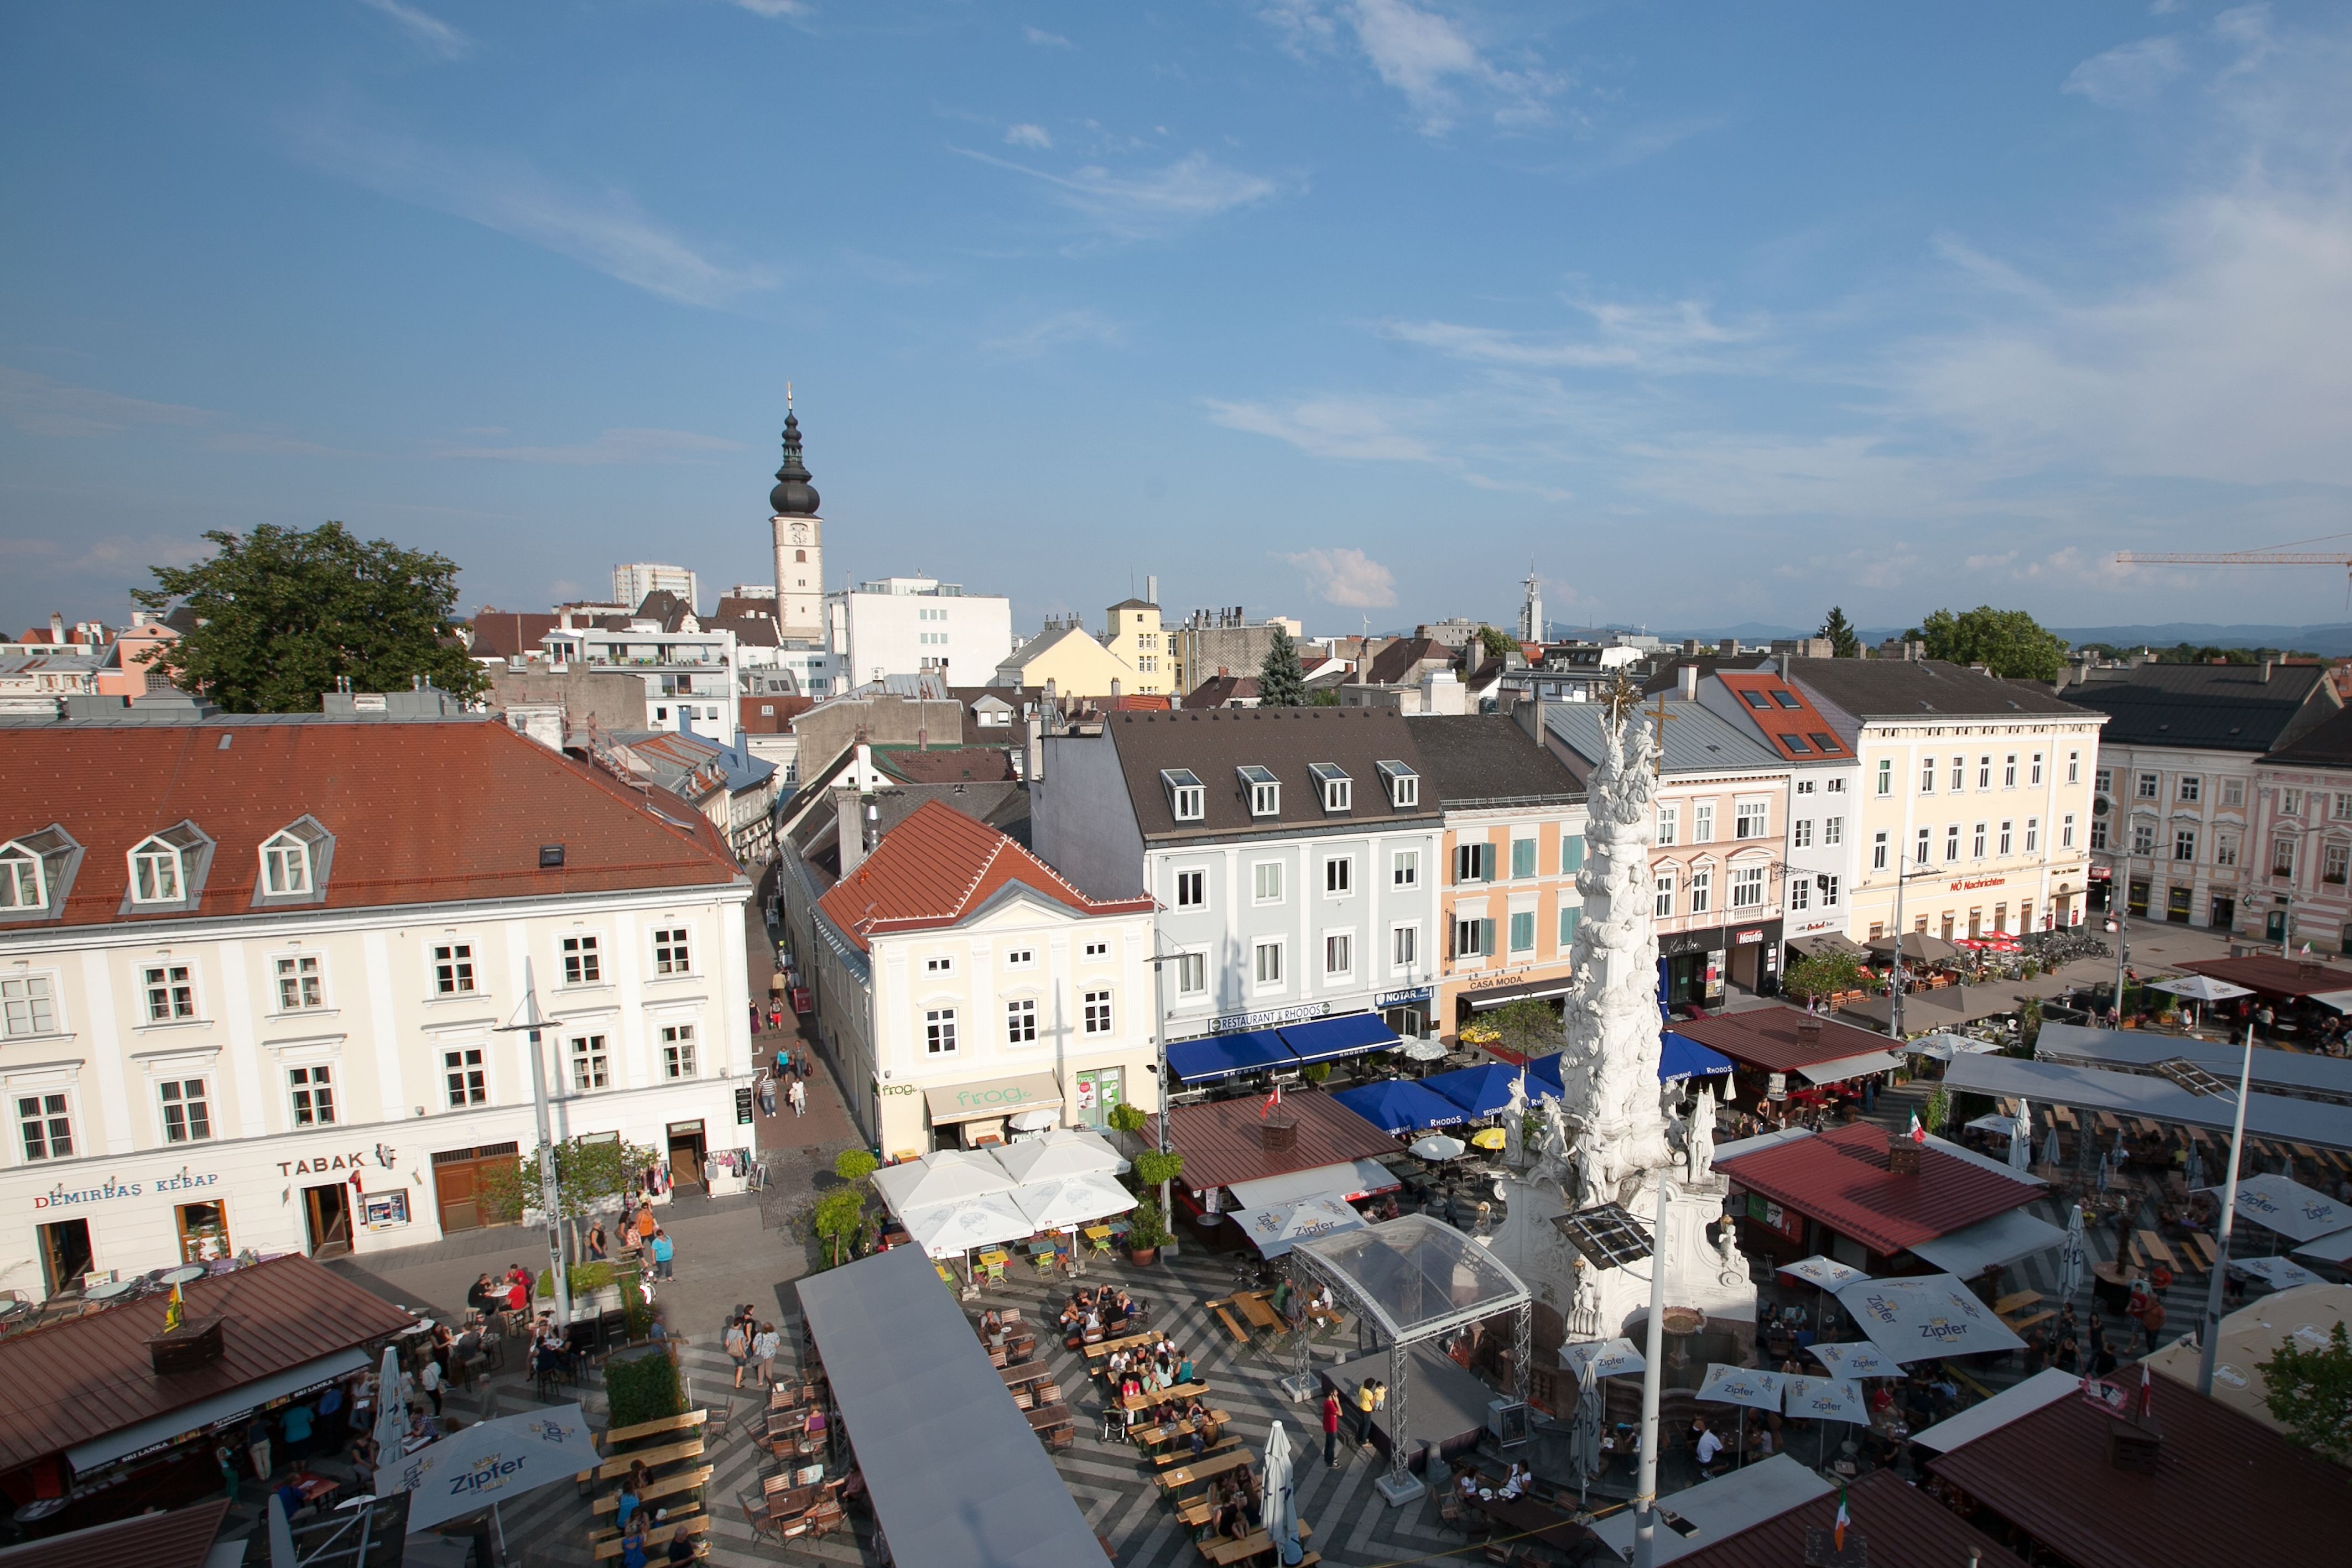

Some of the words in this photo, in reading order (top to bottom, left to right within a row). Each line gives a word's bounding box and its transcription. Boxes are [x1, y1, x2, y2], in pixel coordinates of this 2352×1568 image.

[1964, 877, 2005, 890] Nachrichten
[1739, 932, 1763, 944] Heute
[1470, 978, 1494, 989] CASA
[1386, 991, 1417, 1002] NOTAR
[1222, 1012, 1274, 1029] RESTAURANT
[1285, 1005, 1320, 1020] RHODOS
[1339, 1048, 1369, 1057] RHODOS
[1223, 1066, 1262, 1077] RHODOS
[1666, 1071, 1692, 1081] RESTAURANT
[883, 1085, 913, 1095] frog
[957, 1087, 1023, 1106] frog
[1482, 1106, 1505, 1117] RESTAUR
[1384, 1124, 1411, 1135] STAURANT
[277, 1152, 366, 1176] TABAK
[34, 1184, 142, 1208] DEMIRBAS
[156, 1174, 218, 1192] KEBAP
[2236, 1190, 2280, 1213] Zipfer
[2301, 1205, 2334, 1220] Zipfer
[1257, 1212, 1278, 1233] Zipfer
[1293, 1220, 1335, 1237] Zipfer
[1799, 1264, 1823, 1278] Zipfer
[1866, 1294, 1897, 1324] Zipfer
[1918, 1323, 1968, 1339] Zipfer
[1597, 1356, 1625, 1367] Zipfer
[1851, 1358, 1879, 1369] Zipfer
[294, 1389, 307, 1398] SRI
[307, 1379, 334, 1392] LANKA
[1724, 1384, 1755, 1397] Zipfer
[1812, 1400, 1842, 1411] Zipfer
[121, 1453, 137, 1463] SRI
[138, 1441, 169, 1457] LANKA
[449, 1455, 527, 1496] Zipfer
